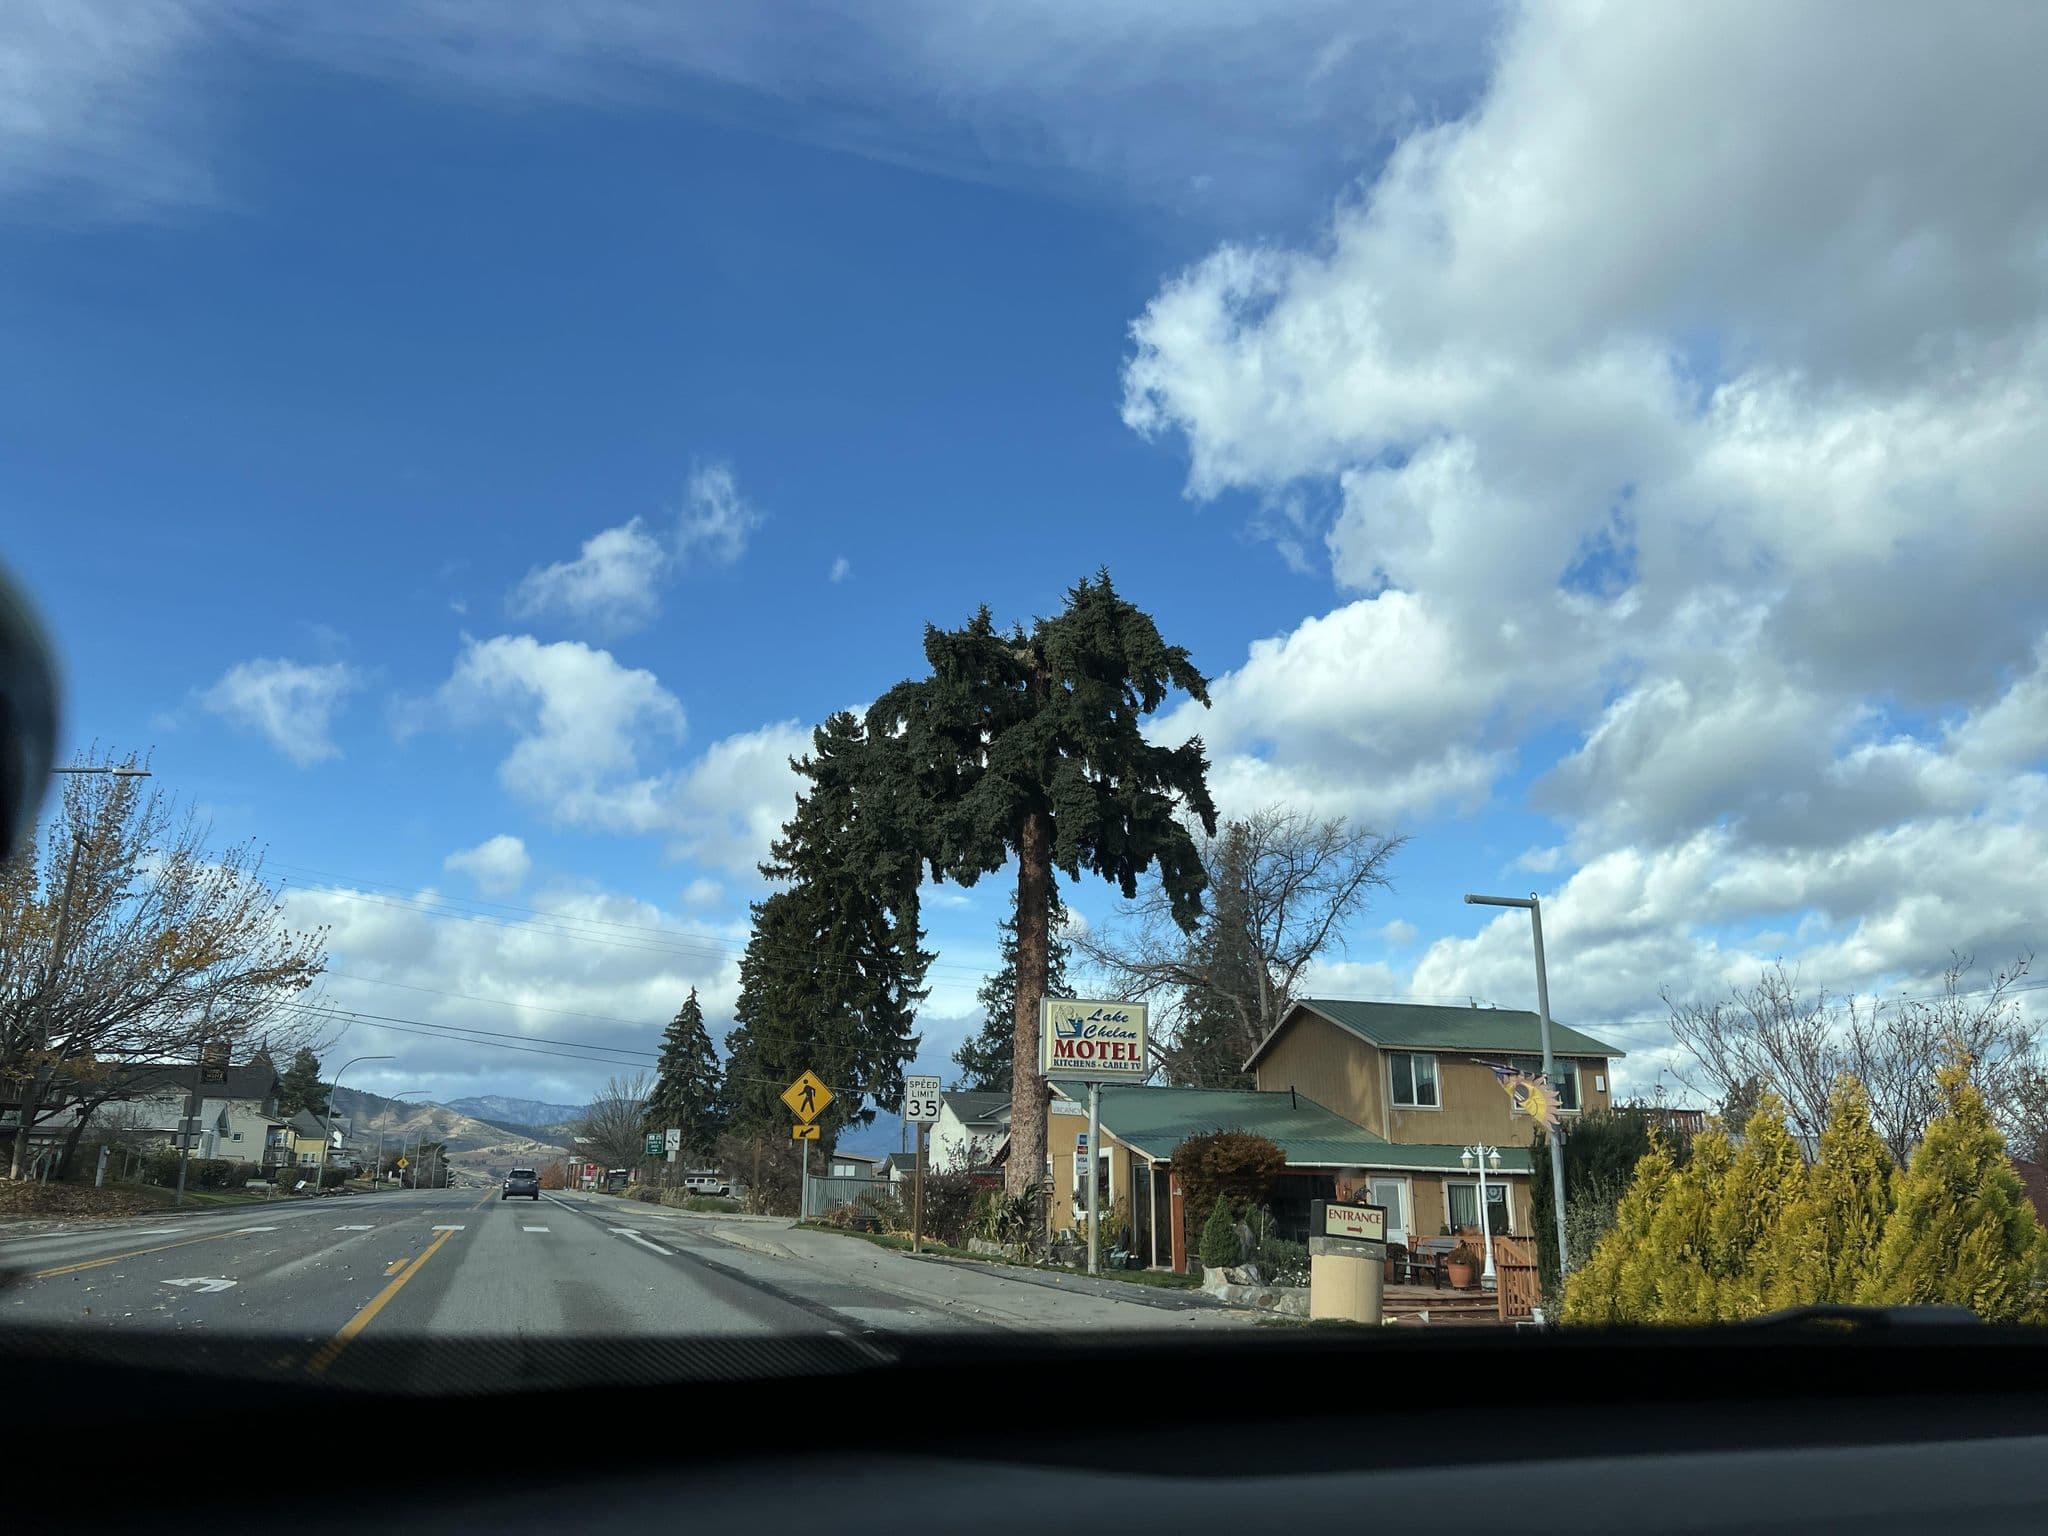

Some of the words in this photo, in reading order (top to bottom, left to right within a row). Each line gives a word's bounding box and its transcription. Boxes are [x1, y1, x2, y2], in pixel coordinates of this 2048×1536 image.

[1087, 1008, 1129, 1023] Lake
[1083, 1024, 1137, 1039] Chelan
[1053, 1039, 1141, 1061] MOTEL
[1053, 1059, 1096, 1068] KITCHENS
[1102, 1061, 1129, 1070] CABLE
[1131, 1062, 1141, 1070] TV
[909, 1080, 938, 1089] SPEED
[911, 1090, 935, 1098] LIMIT
[908, 1100, 937, 1117] 35
[1328, 1208, 1381, 1224] ENTRANCE
